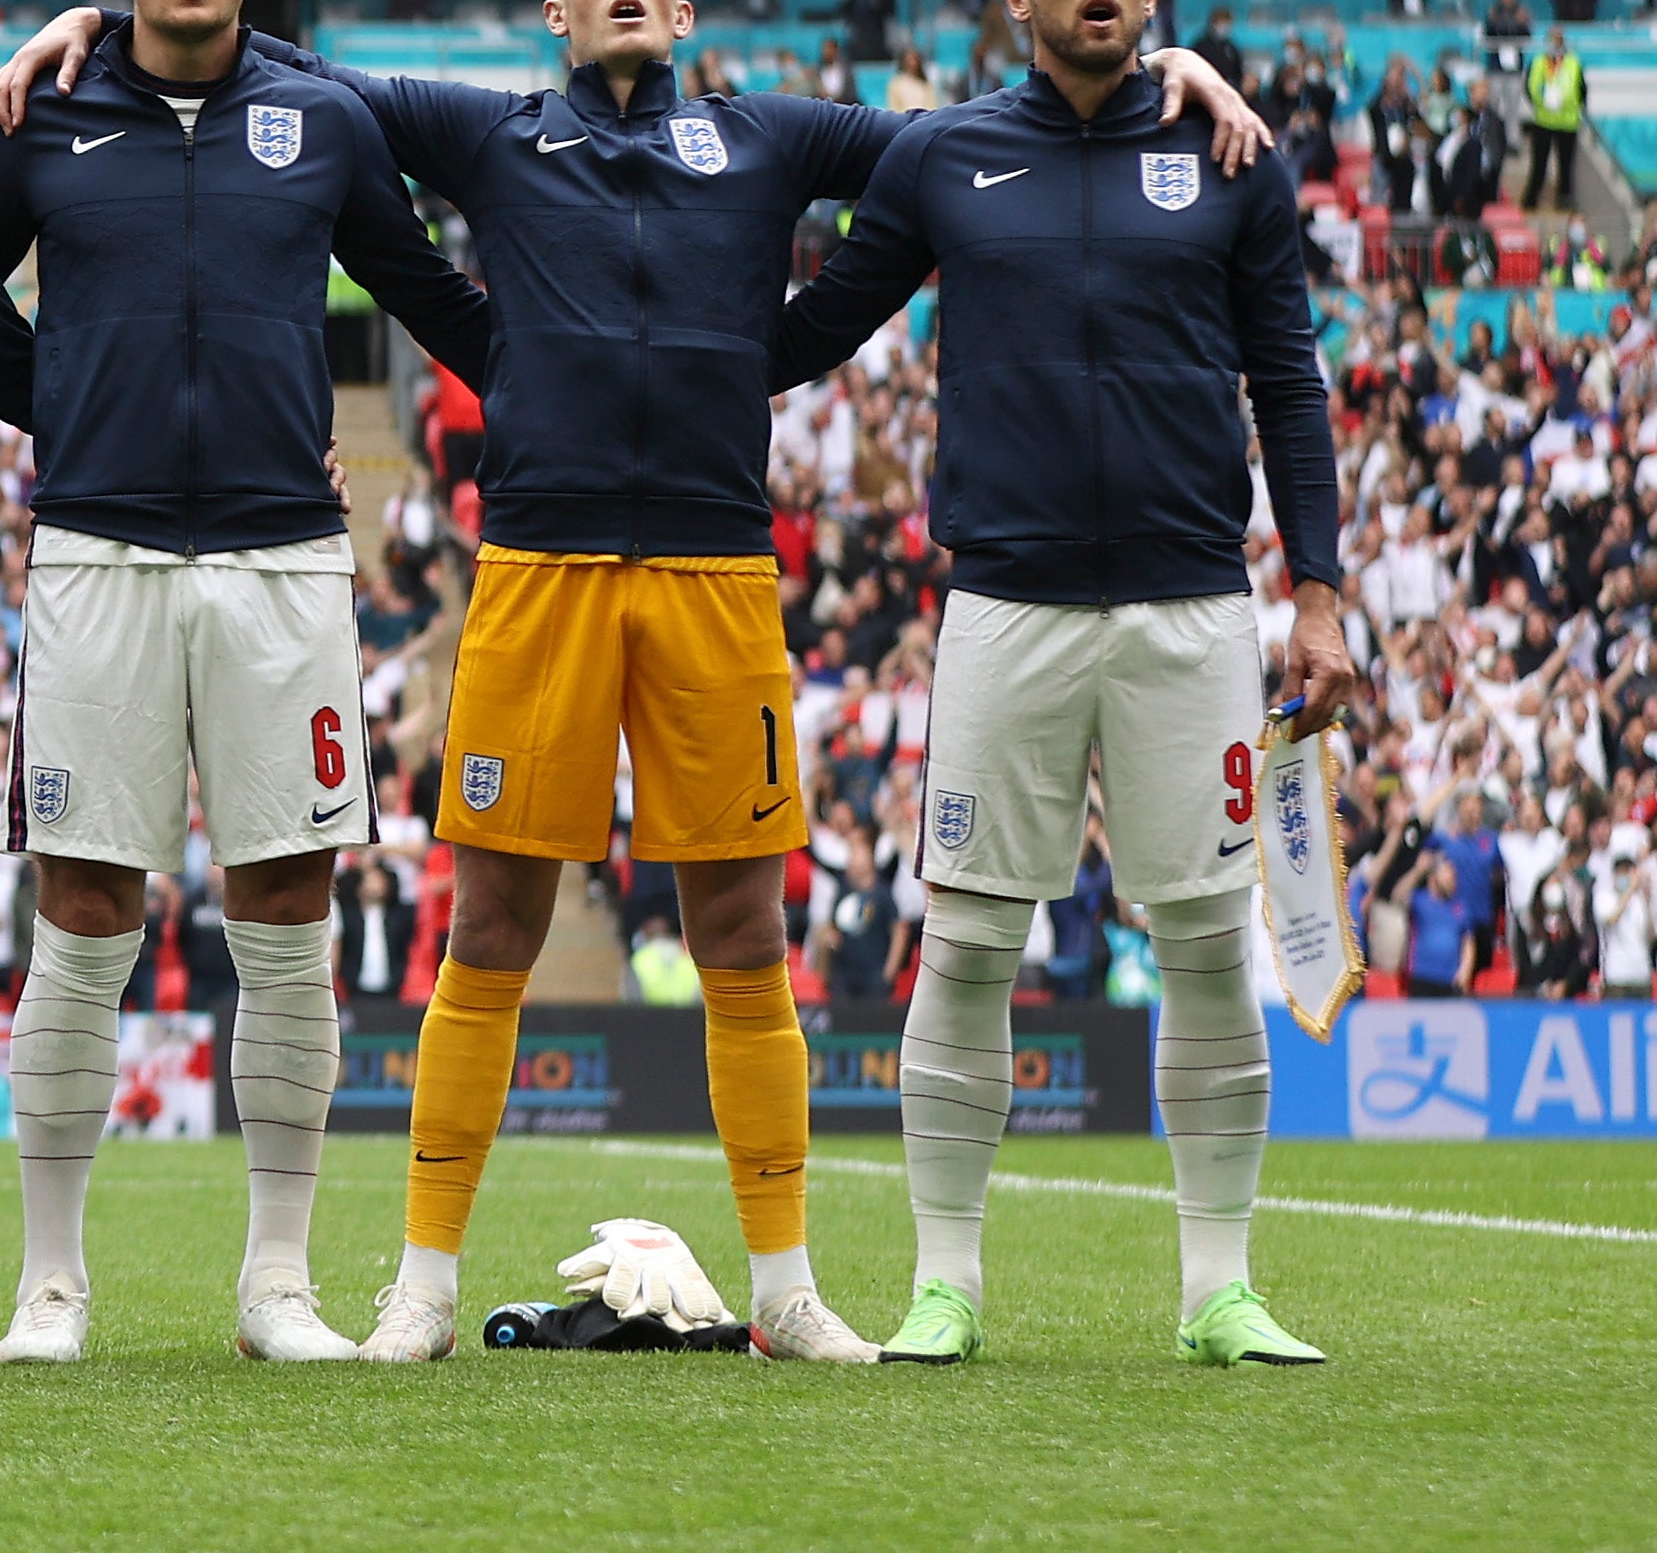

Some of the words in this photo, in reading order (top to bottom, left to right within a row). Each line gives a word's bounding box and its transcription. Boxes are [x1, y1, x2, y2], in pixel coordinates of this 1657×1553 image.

[310, 706, 347, 790] 6
[760, 704, 779, 786] 1
[1223, 740, 1255, 826] 9
